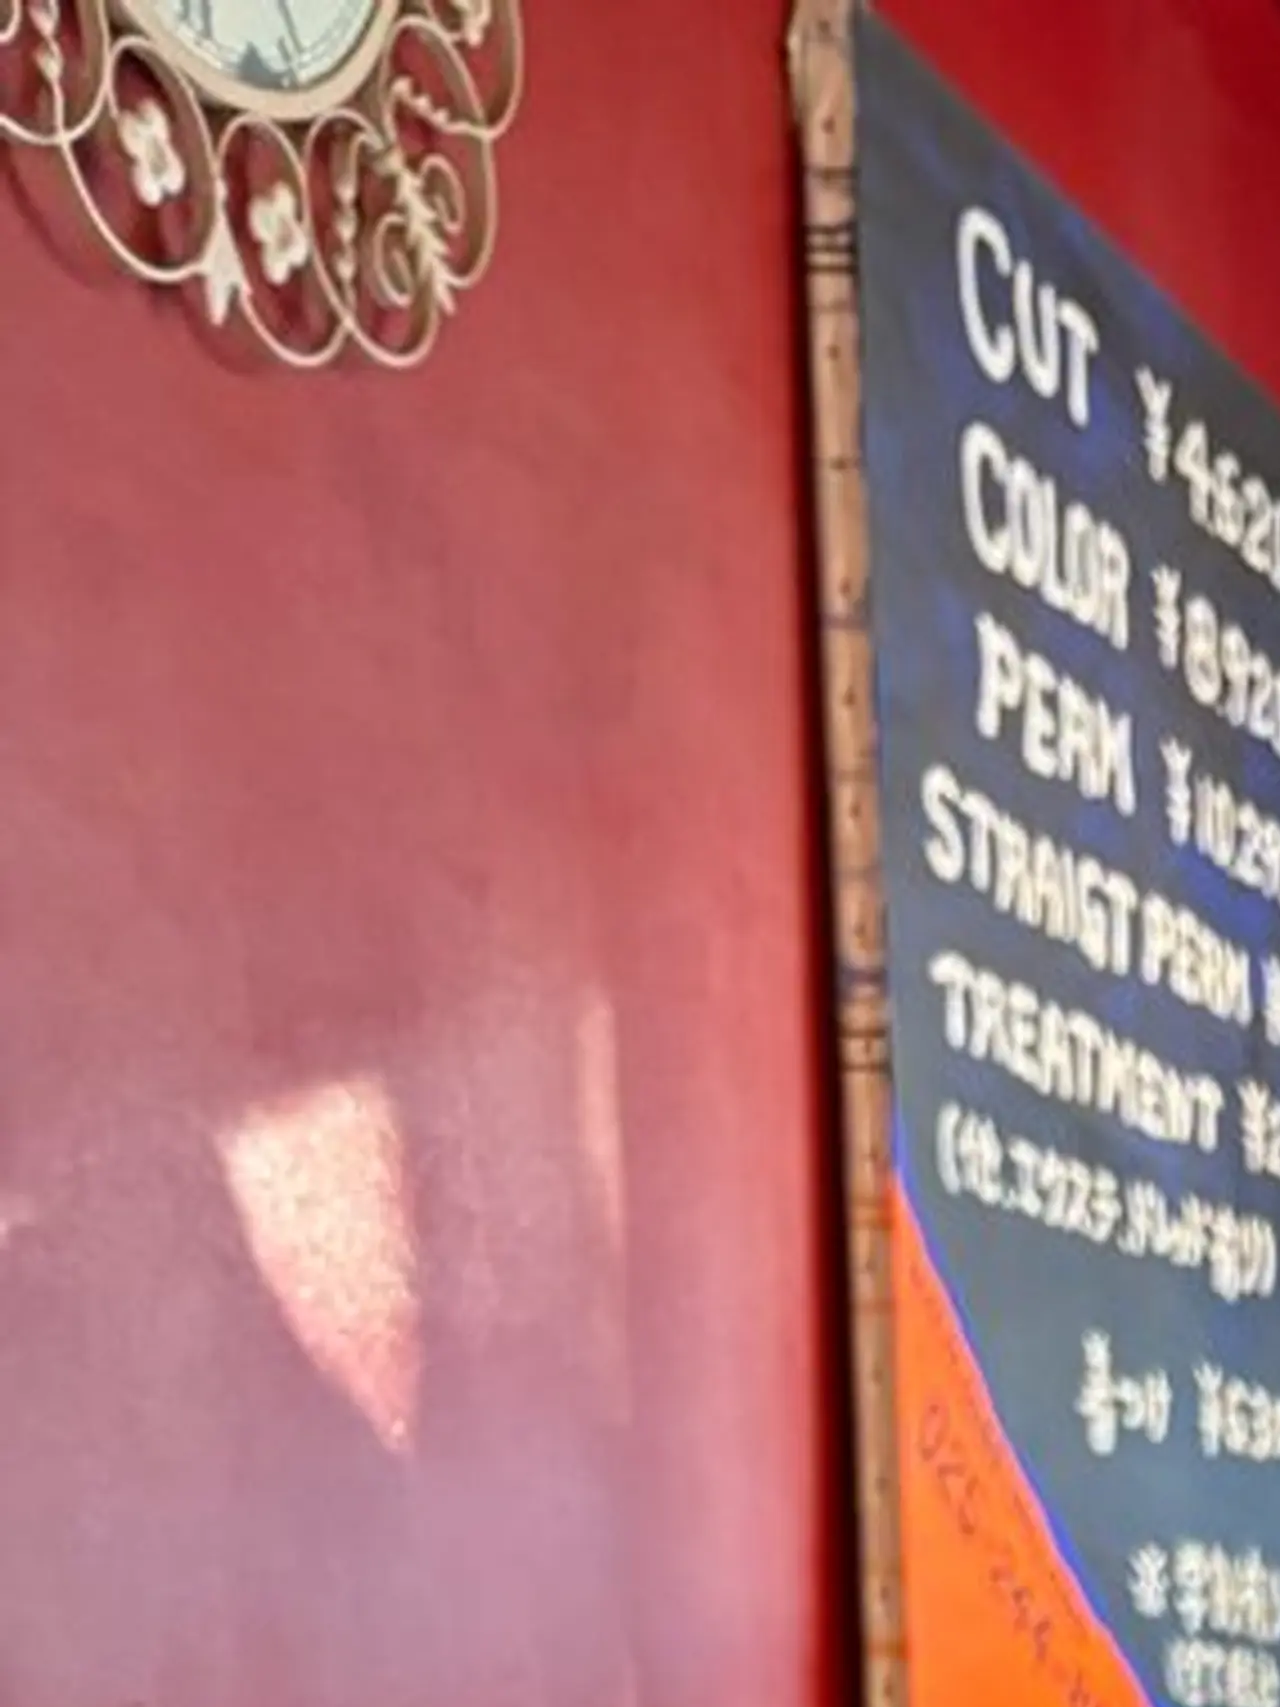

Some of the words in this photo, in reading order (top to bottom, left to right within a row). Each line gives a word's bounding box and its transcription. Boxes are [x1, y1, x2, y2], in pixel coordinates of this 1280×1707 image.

[957, 206, 1099, 428] CUT
[961, 421, 1130, 650] COLOR
[974, 611, 1135, 816] PERM
[921, 763, 1137, 977] STRAIGT
[1140, 890, 1252, 1027] PERM
[928, 950, 1224, 1153] TREATMENT
